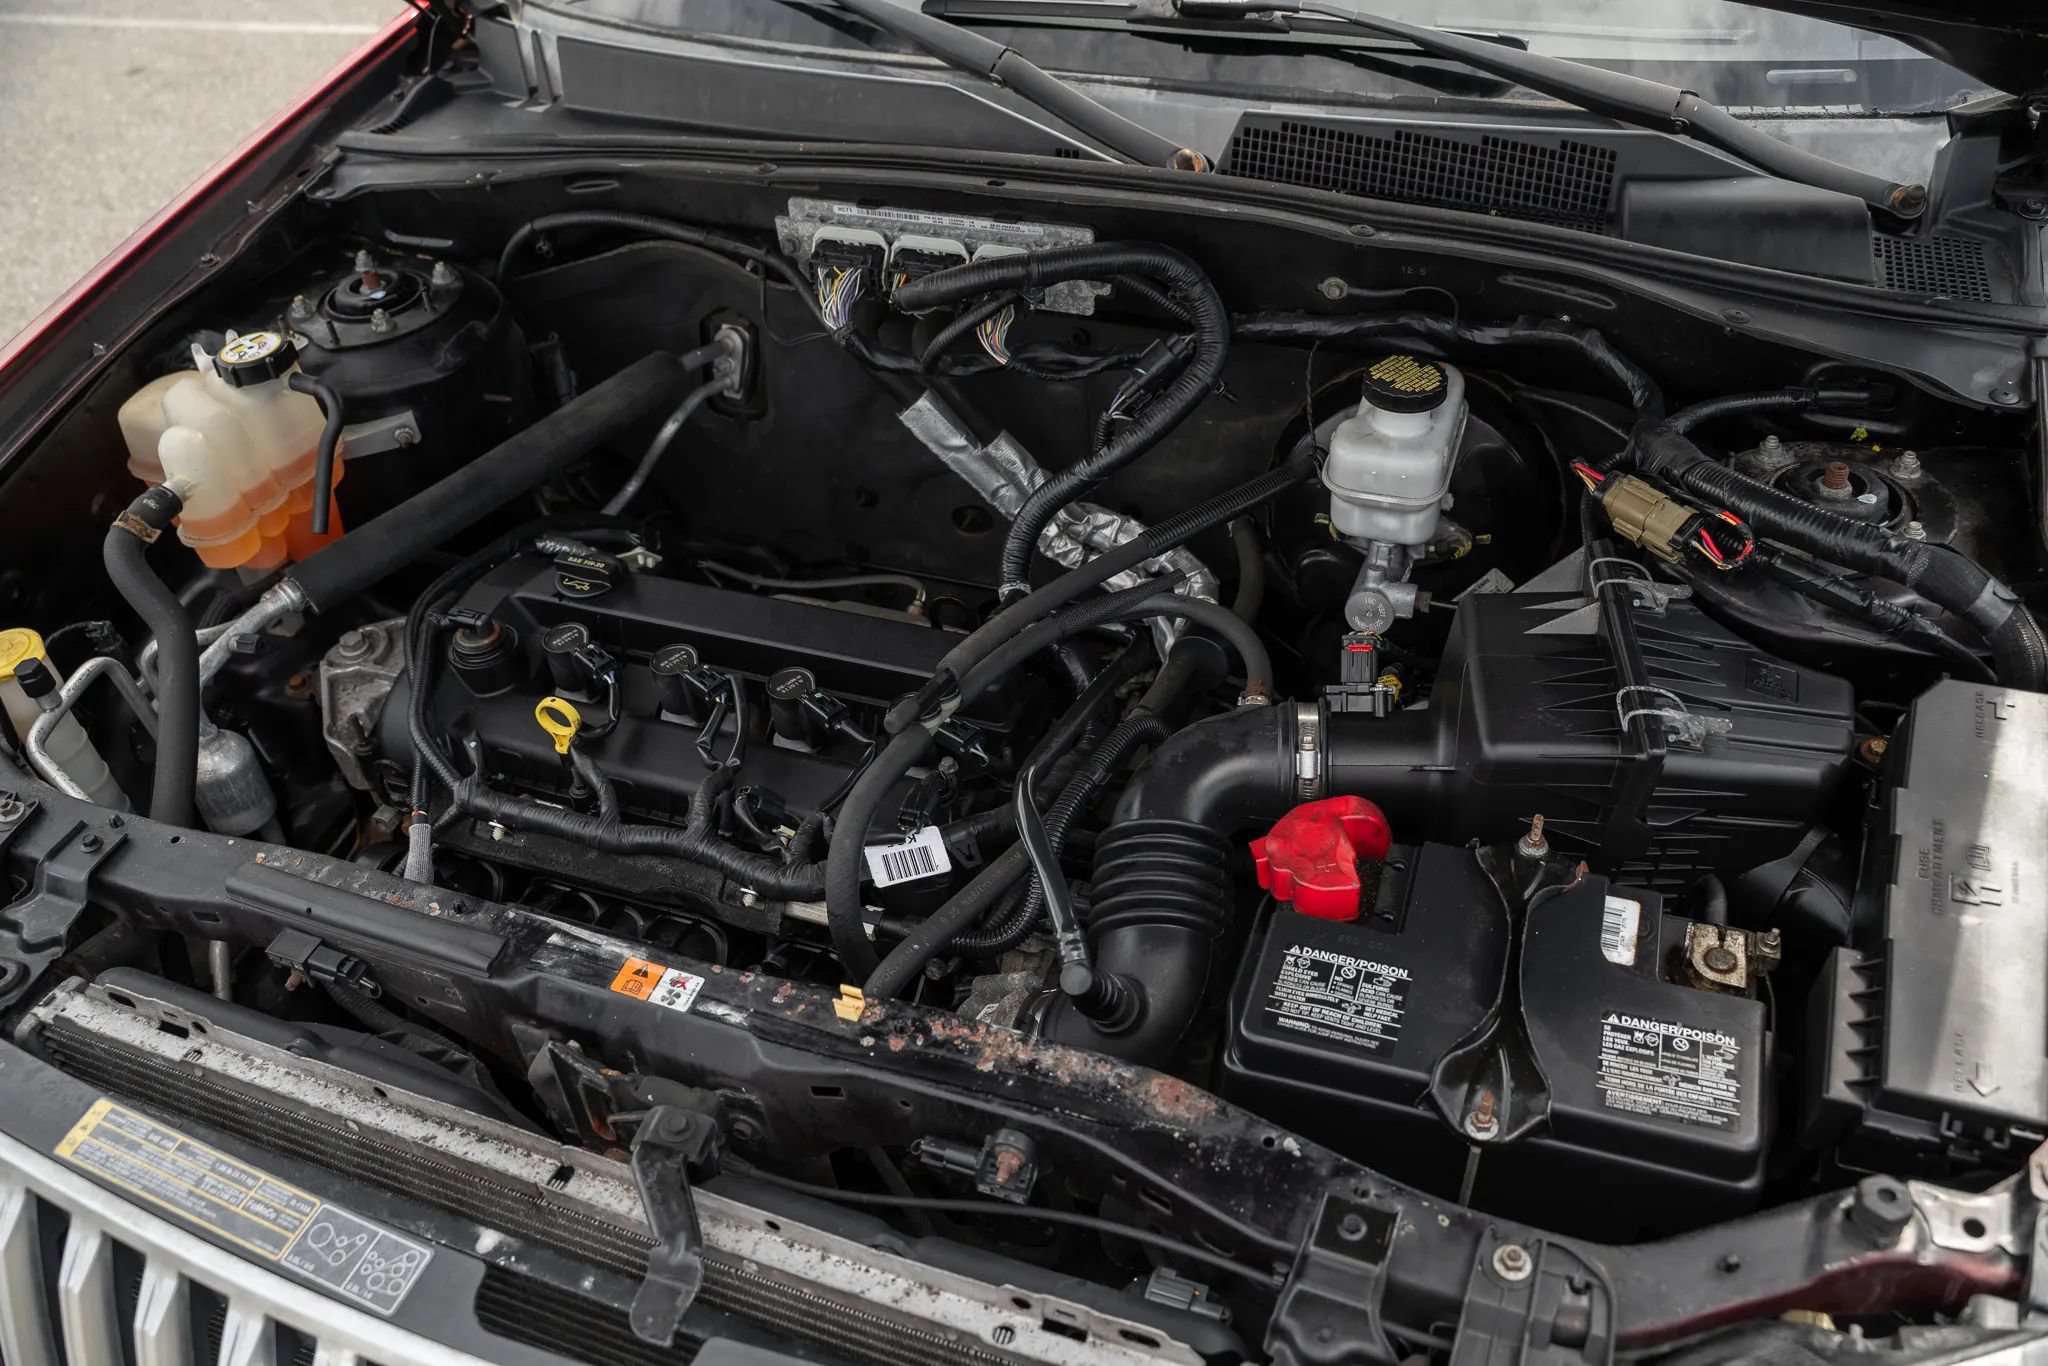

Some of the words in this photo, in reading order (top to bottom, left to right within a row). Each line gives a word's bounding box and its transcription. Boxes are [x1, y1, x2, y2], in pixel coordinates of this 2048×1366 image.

[1918, 848, 1930, 880] FUSE
[1931, 818, 1944, 916] COMPARTMENT
[1302, 946, 1408, 978] DANGER/POISON
[1322, 1009, 1342, 1019] REACH
[1376, 1008, 1398, 1018] MEDICAL
[1621, 1015, 1736, 1046] DANGER/POISON
